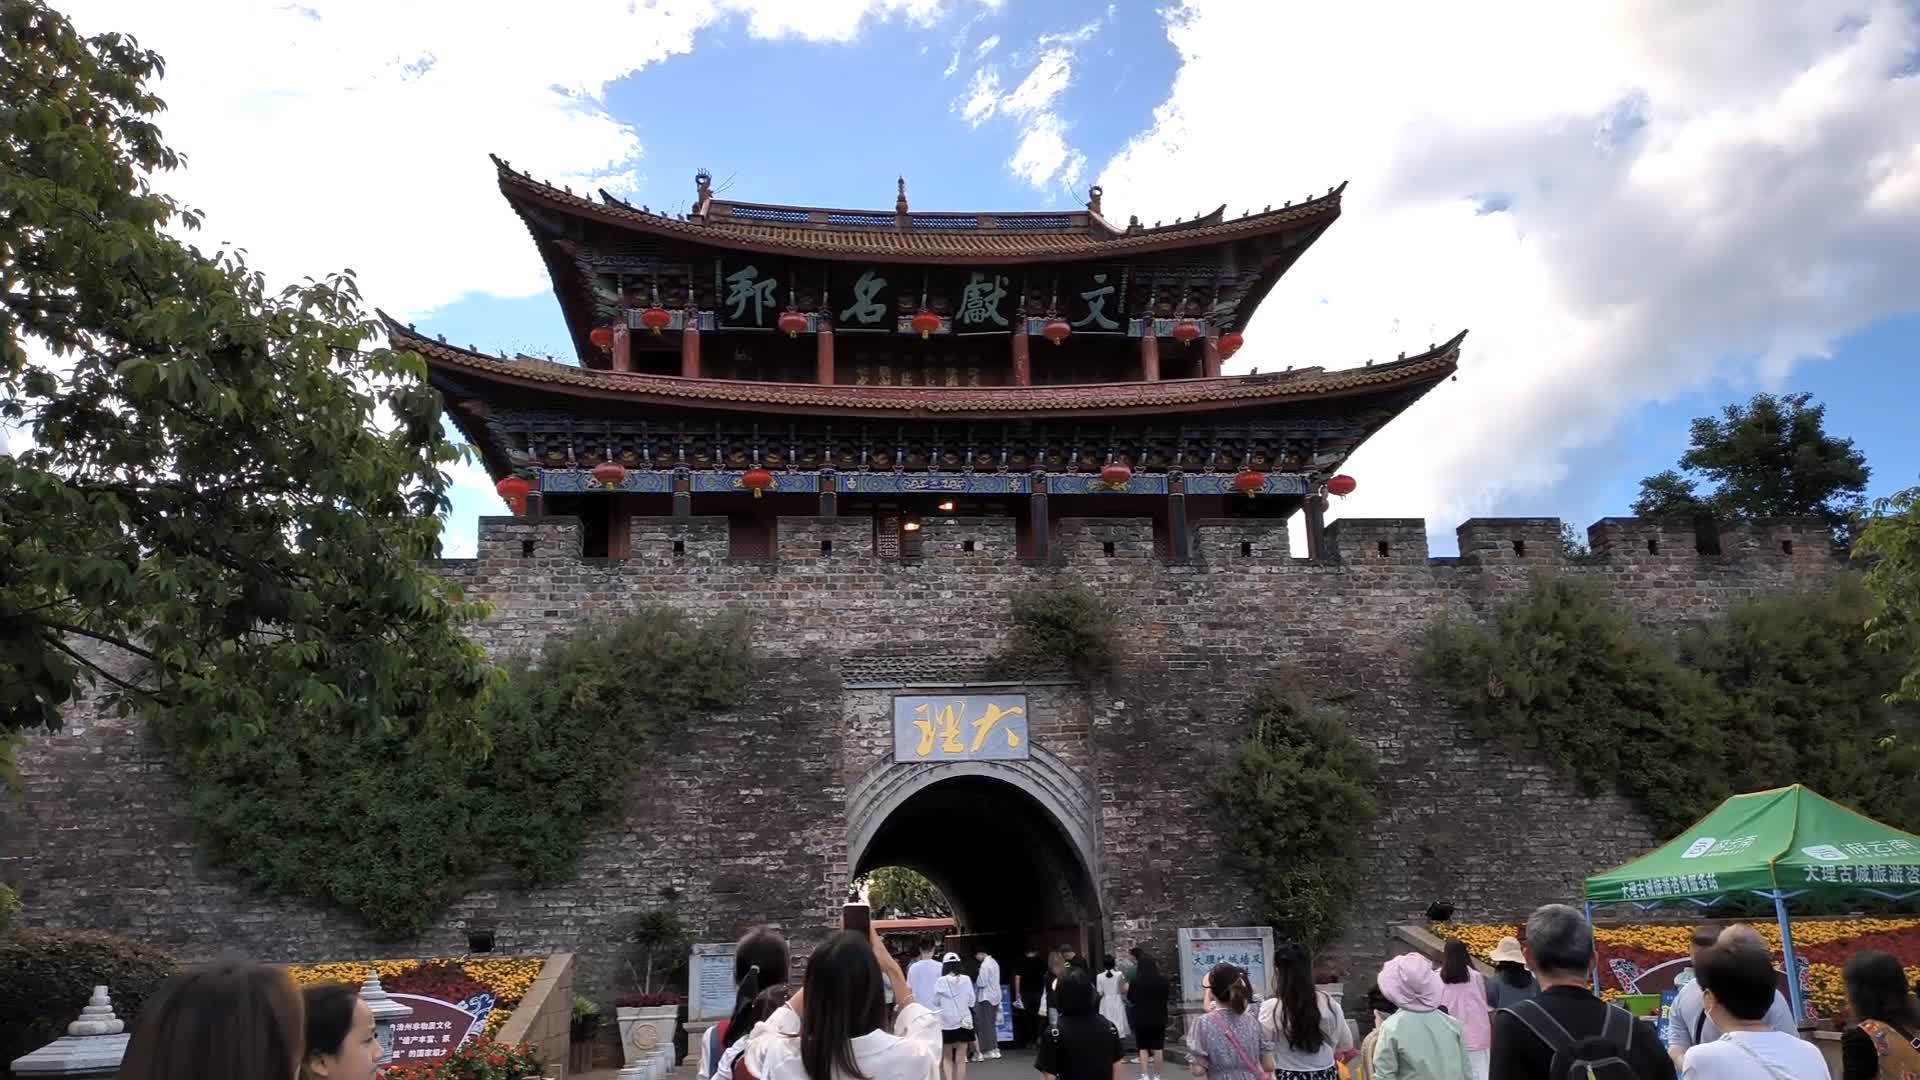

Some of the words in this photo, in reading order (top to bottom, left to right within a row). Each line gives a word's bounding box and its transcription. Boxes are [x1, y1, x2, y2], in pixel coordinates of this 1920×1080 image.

[1621, 872, 1719, 899] 大理古城旅游咨询服务站
